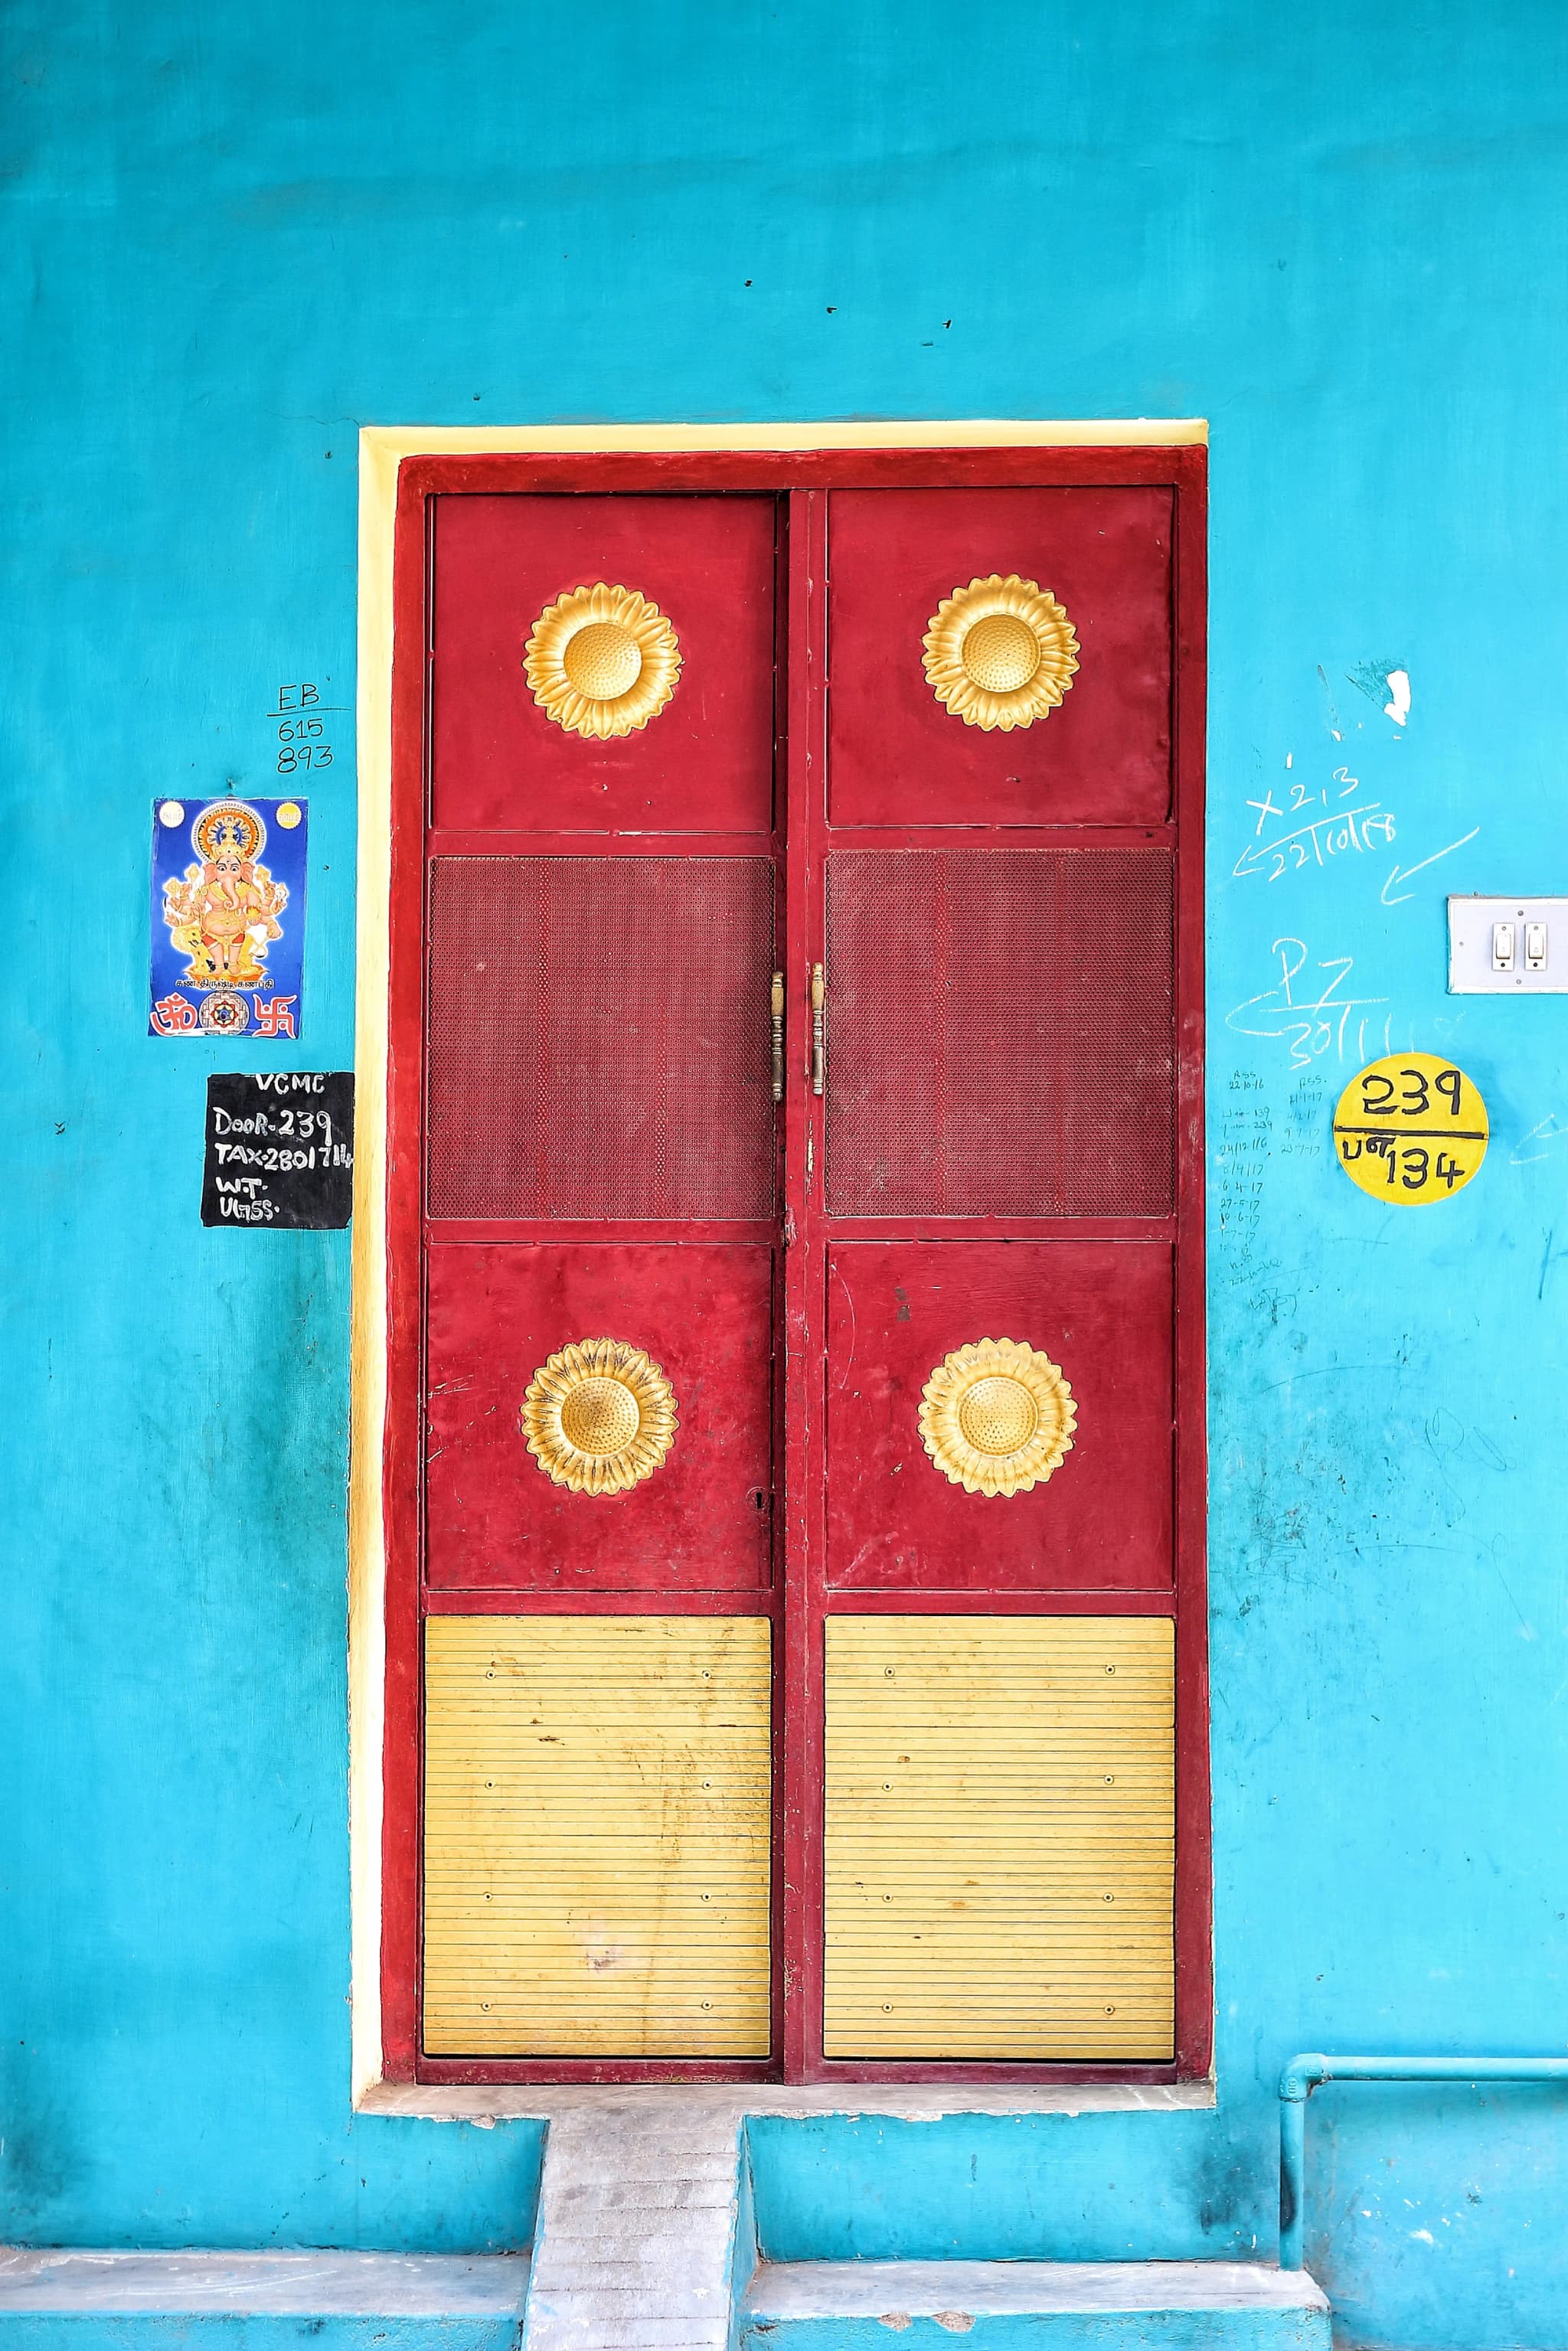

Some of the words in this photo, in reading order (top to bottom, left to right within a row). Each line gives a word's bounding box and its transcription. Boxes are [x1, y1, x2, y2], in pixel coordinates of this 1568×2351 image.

[279, 684, 319, 710] EB
[279, 718, 323, 742] 615
[277, 746, 333, 773] 893
[255, 1073, 325, 1095] VCMC
[1362, 1069, 1461, 1115] 239
